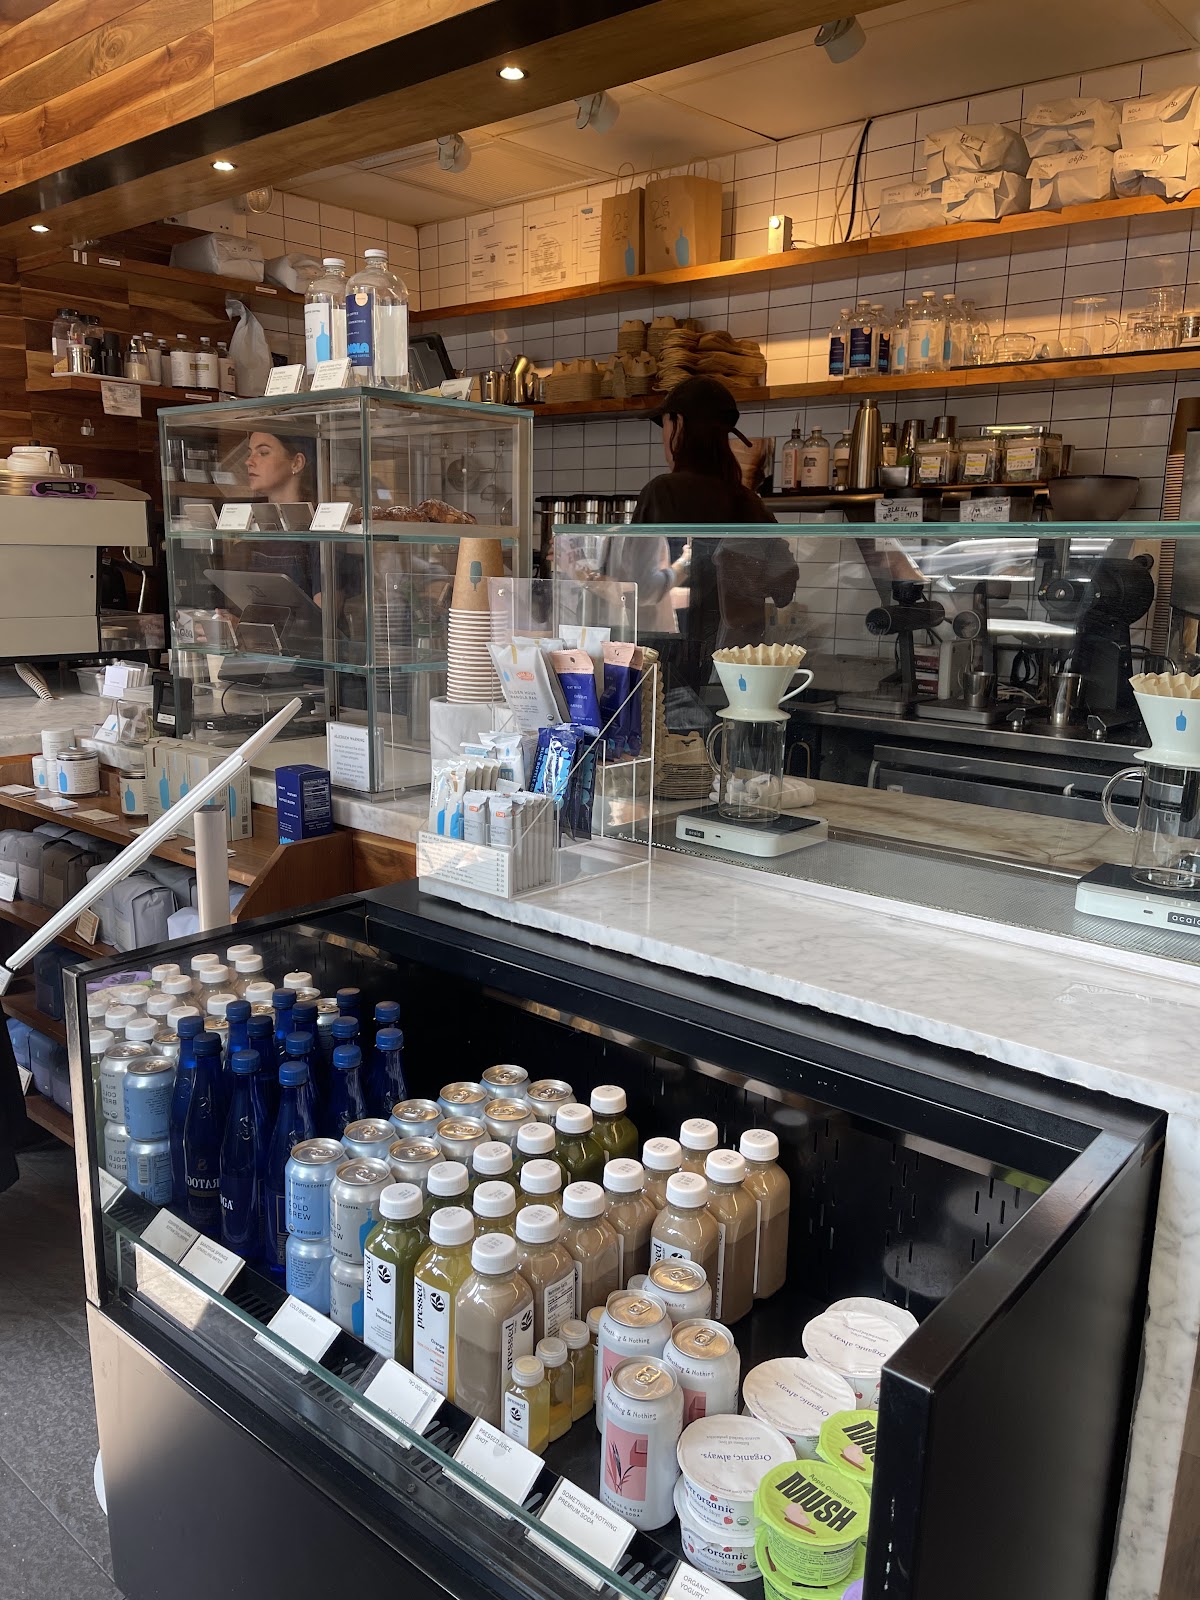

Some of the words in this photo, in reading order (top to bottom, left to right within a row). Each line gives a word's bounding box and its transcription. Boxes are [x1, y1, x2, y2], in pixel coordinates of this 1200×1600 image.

[200, 1240, 216, 1254] SARATOGA
[214, 1250, 228, 1262] SPRINGS
[365, 1254, 374, 1301] pressed
[289, 1302, 299, 1312] COLD
[298, 1308, 309, 1318] BREW
[308, 1314, 316, 1322] CAN
[415, 1282, 425, 1330] pressed
[431, 1338, 445, 1350] Orange
[691, 1369, 714, 1378] Nothing
[774, 1380, 799, 1400] always.
[606, 1392, 625, 1416] Something
[633, 1412, 657, 1421] Nothing
[800, 1396, 830, 1418] Organic,
[475, 1434, 488, 1446] SHOT
[479, 1428, 500, 1445] PRESSED
[499, 1440, 512, 1454] JUICE
[700, 1452, 732, 1462] always.
[734, 1452, 772, 1462] Organic,
[808, 1473, 826, 1488] Apple
[826, 1486, 854, 1506] Cinnamon
[558, 1496, 580, 1516] PREMIUM
[580, 1511, 594, 1526] SODA
[562, 1489, 590, 1516] SOMETHING
[593, 1512, 618, 1532] NOTHING
[697, 1493, 735, 1514] organic
[775, 1471, 858, 1532] MUSH
[707, 1548, 748, 1560] organic
[680, 1583, 704, 1600] YOGURT
[683, 1575, 710, 1594] ORGANIC
